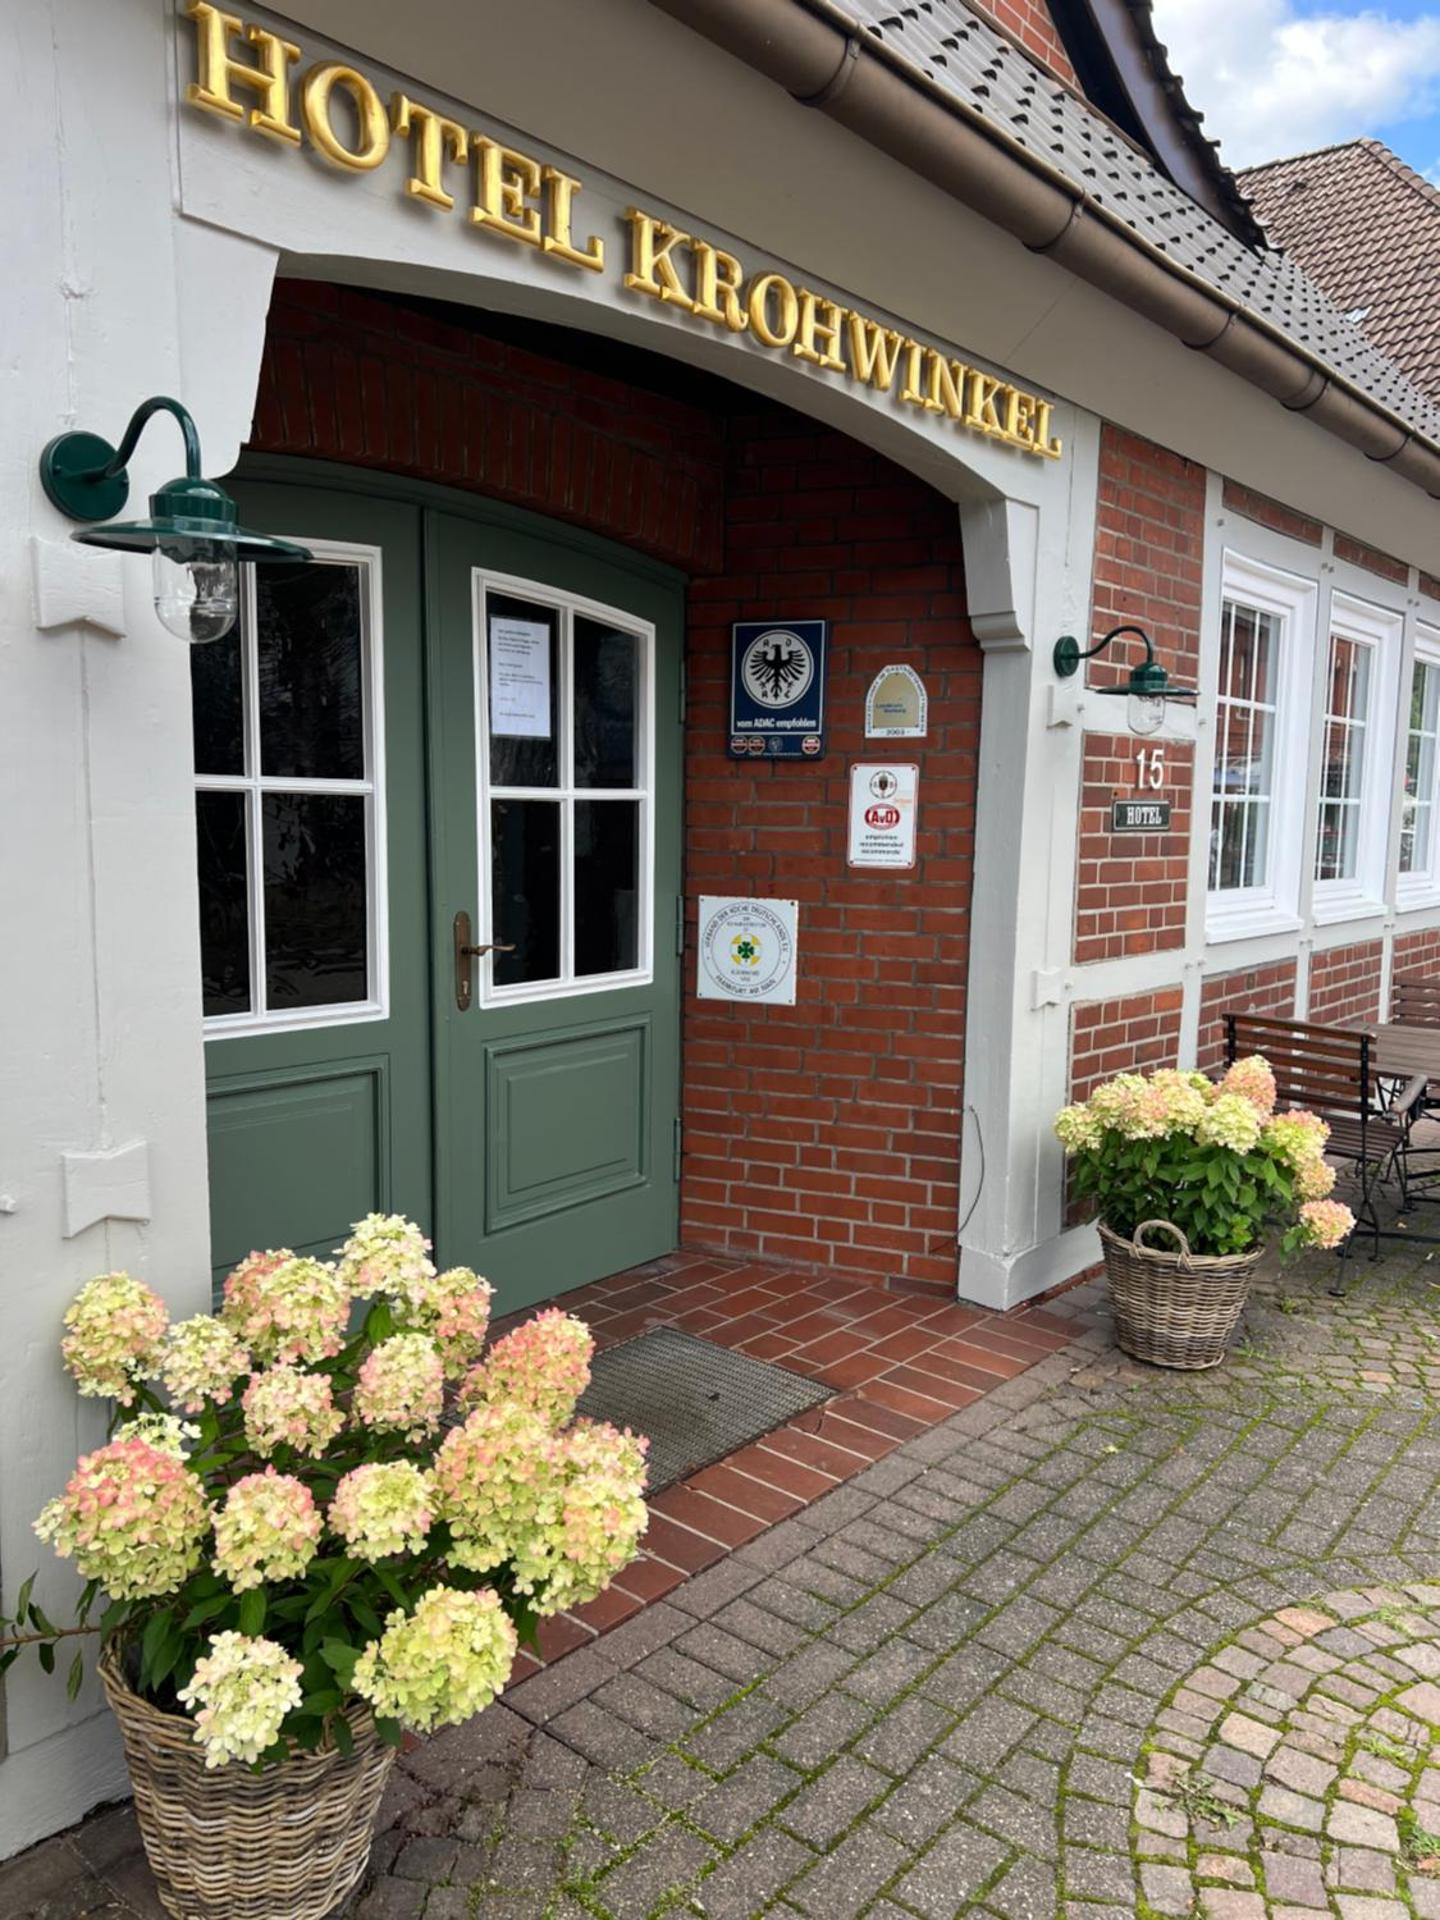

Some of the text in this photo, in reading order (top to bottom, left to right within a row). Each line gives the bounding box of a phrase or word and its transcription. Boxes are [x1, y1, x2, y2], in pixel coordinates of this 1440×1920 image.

[186, 1, 1063, 461] HOTEL KROHWINKEL
[753, 717, 776, 728] ADAC
[776, 717, 817, 730] empfohlen
[1136, 748, 1165, 790] 15
[872, 811, 893, 823] AvD
[1126, 806, 1162, 825] HOTEL
